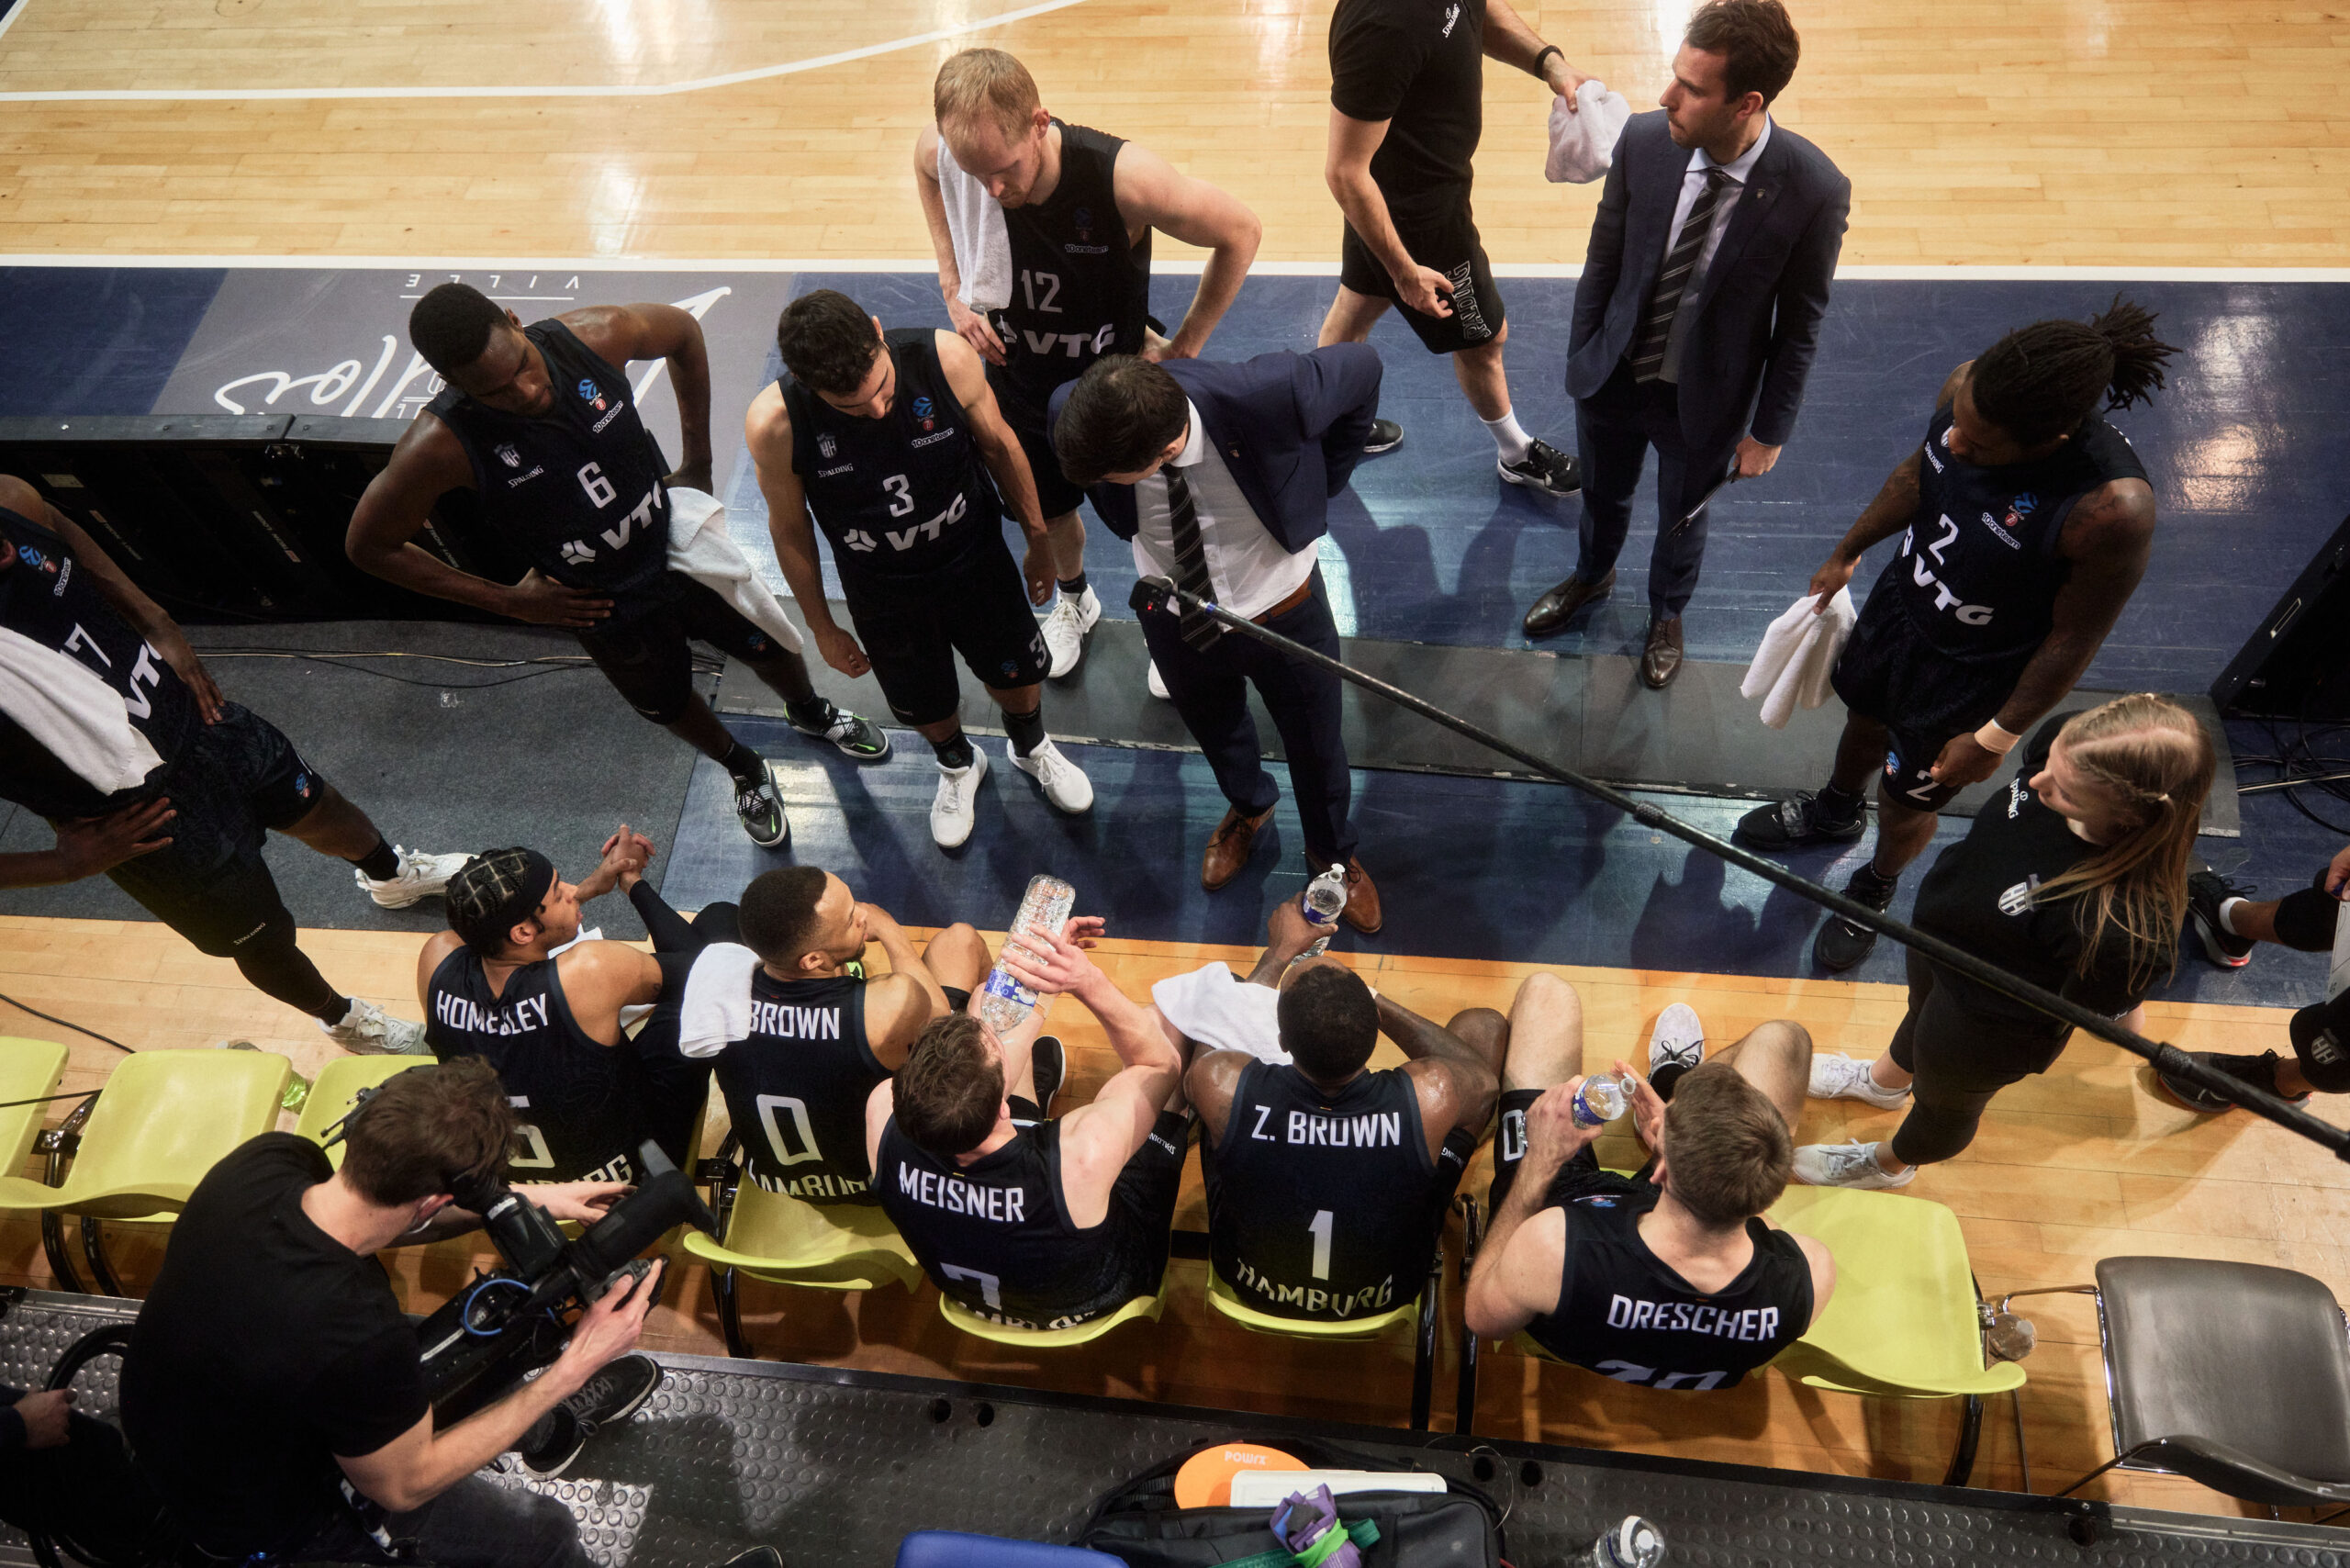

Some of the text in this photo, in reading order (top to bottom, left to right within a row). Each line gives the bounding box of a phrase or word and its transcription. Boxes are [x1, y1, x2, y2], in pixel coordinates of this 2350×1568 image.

[1442, 3, 1460, 39] SPALDING
[1021, 269, 1063, 314] 12
[1445, 260, 1493, 341] SPALDING
[1023, 322, 1115, 358] VTG
[911, 427, 955, 449] 10oneteam
[1924, 441, 1945, 475] SPALDING
[508, 465, 544, 488] SPALDING
[576, 461, 617, 509] 6
[818, 463, 854, 478] SPALDING
[882, 474, 915, 518] 3
[884, 492, 967, 551] VTG
[1929, 513, 1959, 566] 2
[1981, 512, 2021, 550] 10oneteam
[1913, 553, 1996, 626] VTG
[1028, 631, 1048, 669] 3
[750, 1000, 840, 1040] BROWN
[756, 1093, 823, 1166] 0
[1147, 1132, 1177, 1155] SPALDIN
[1251, 1104, 1401, 1148] Z. BROWN
[899, 1160, 1025, 1223] MEISNER
[1308, 1209, 1334, 1281] 1
[1236, 1257, 1393, 1317] HAMBURG
[1606, 1294, 1780, 1341] DRESCHER
